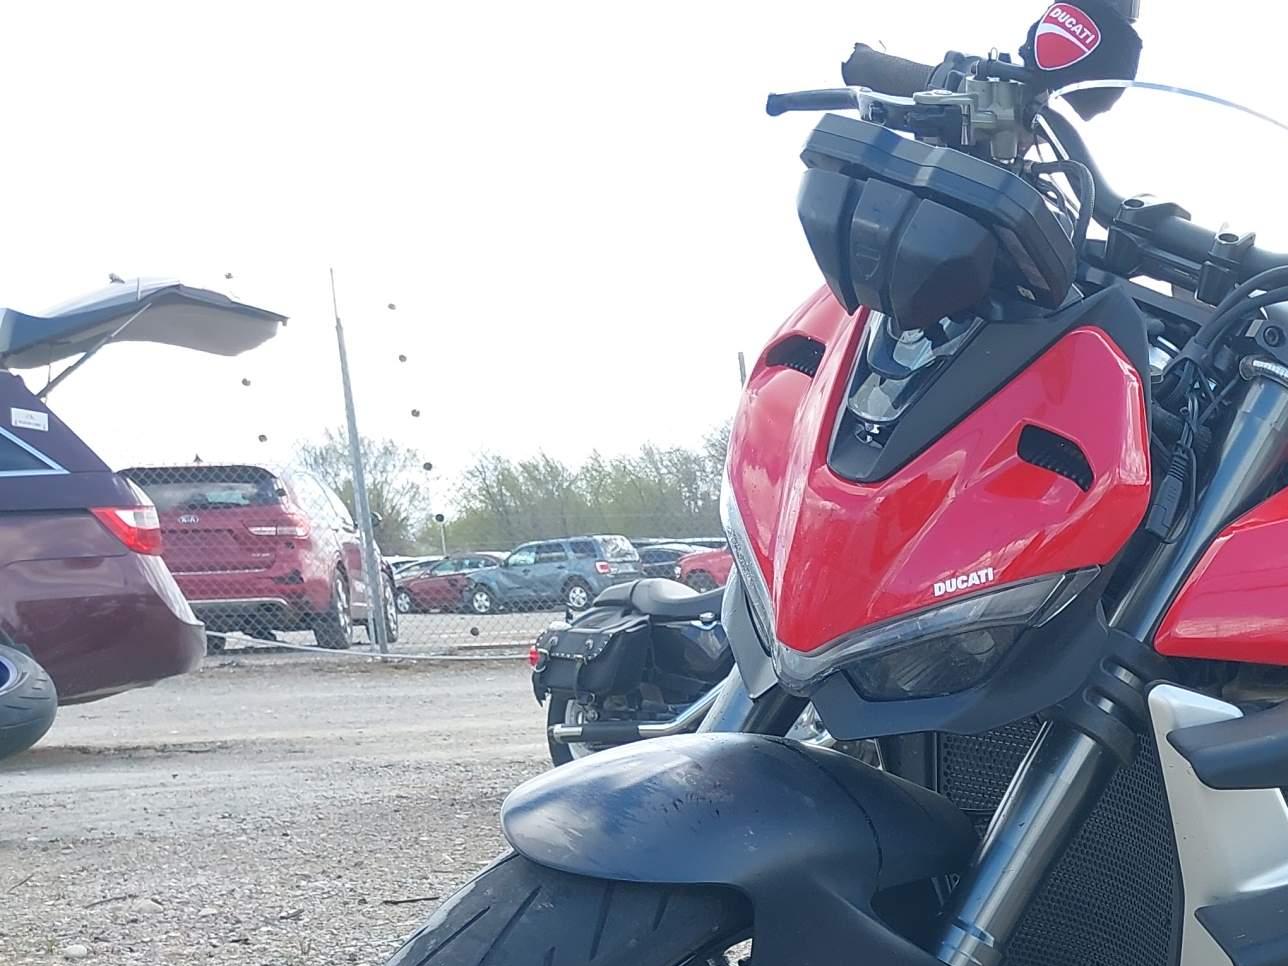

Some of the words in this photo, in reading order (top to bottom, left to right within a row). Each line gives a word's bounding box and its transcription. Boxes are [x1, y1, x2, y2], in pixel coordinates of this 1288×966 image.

[1049, 7, 1096, 44] DUCATI
[178, 515, 199, 524] KIA
[933, 567, 994, 597] DUCATI
